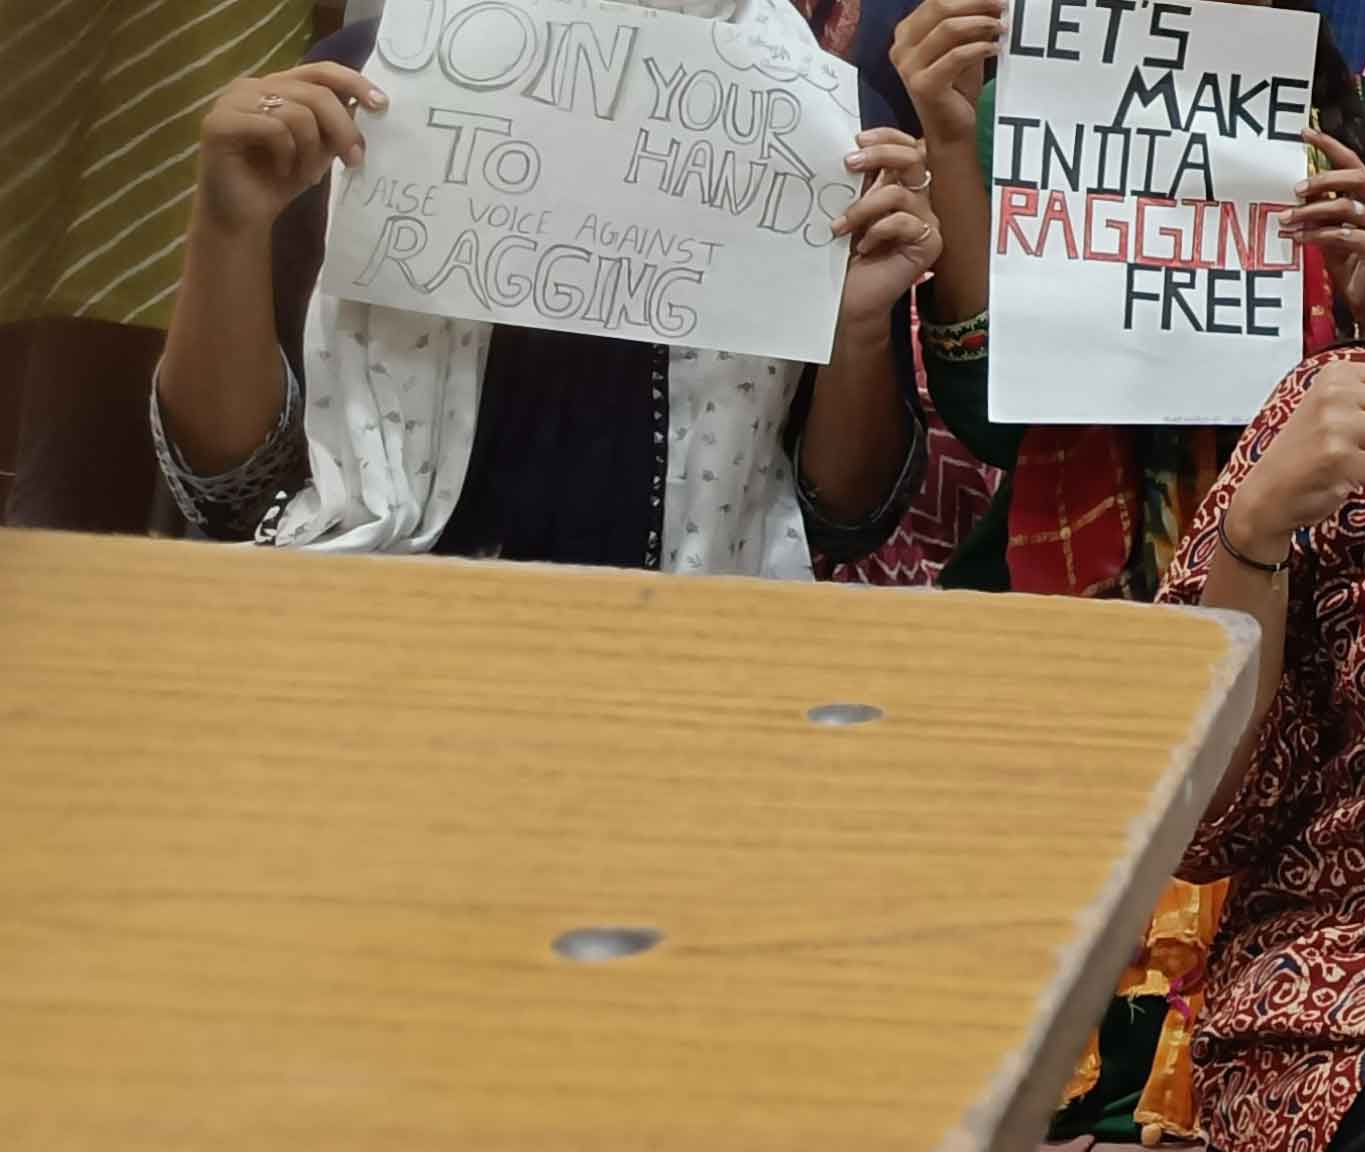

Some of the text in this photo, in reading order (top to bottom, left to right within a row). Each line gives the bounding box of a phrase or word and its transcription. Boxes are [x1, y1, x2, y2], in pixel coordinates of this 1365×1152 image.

[643, 56, 815, 181] YOUR
[1112, 66, 1310, 142] MAKE
[427, 108, 855, 249] TO HANDS
[994, 115, 1216, 202] INDIA
[469, 197, 552, 235] VOICE
[575, 213, 725, 267] AGAINST
[996, 185, 1301, 272] RAGGING
[353, 215, 705, 339] RAGGING
[1123, 263, 1284, 337] FREE
